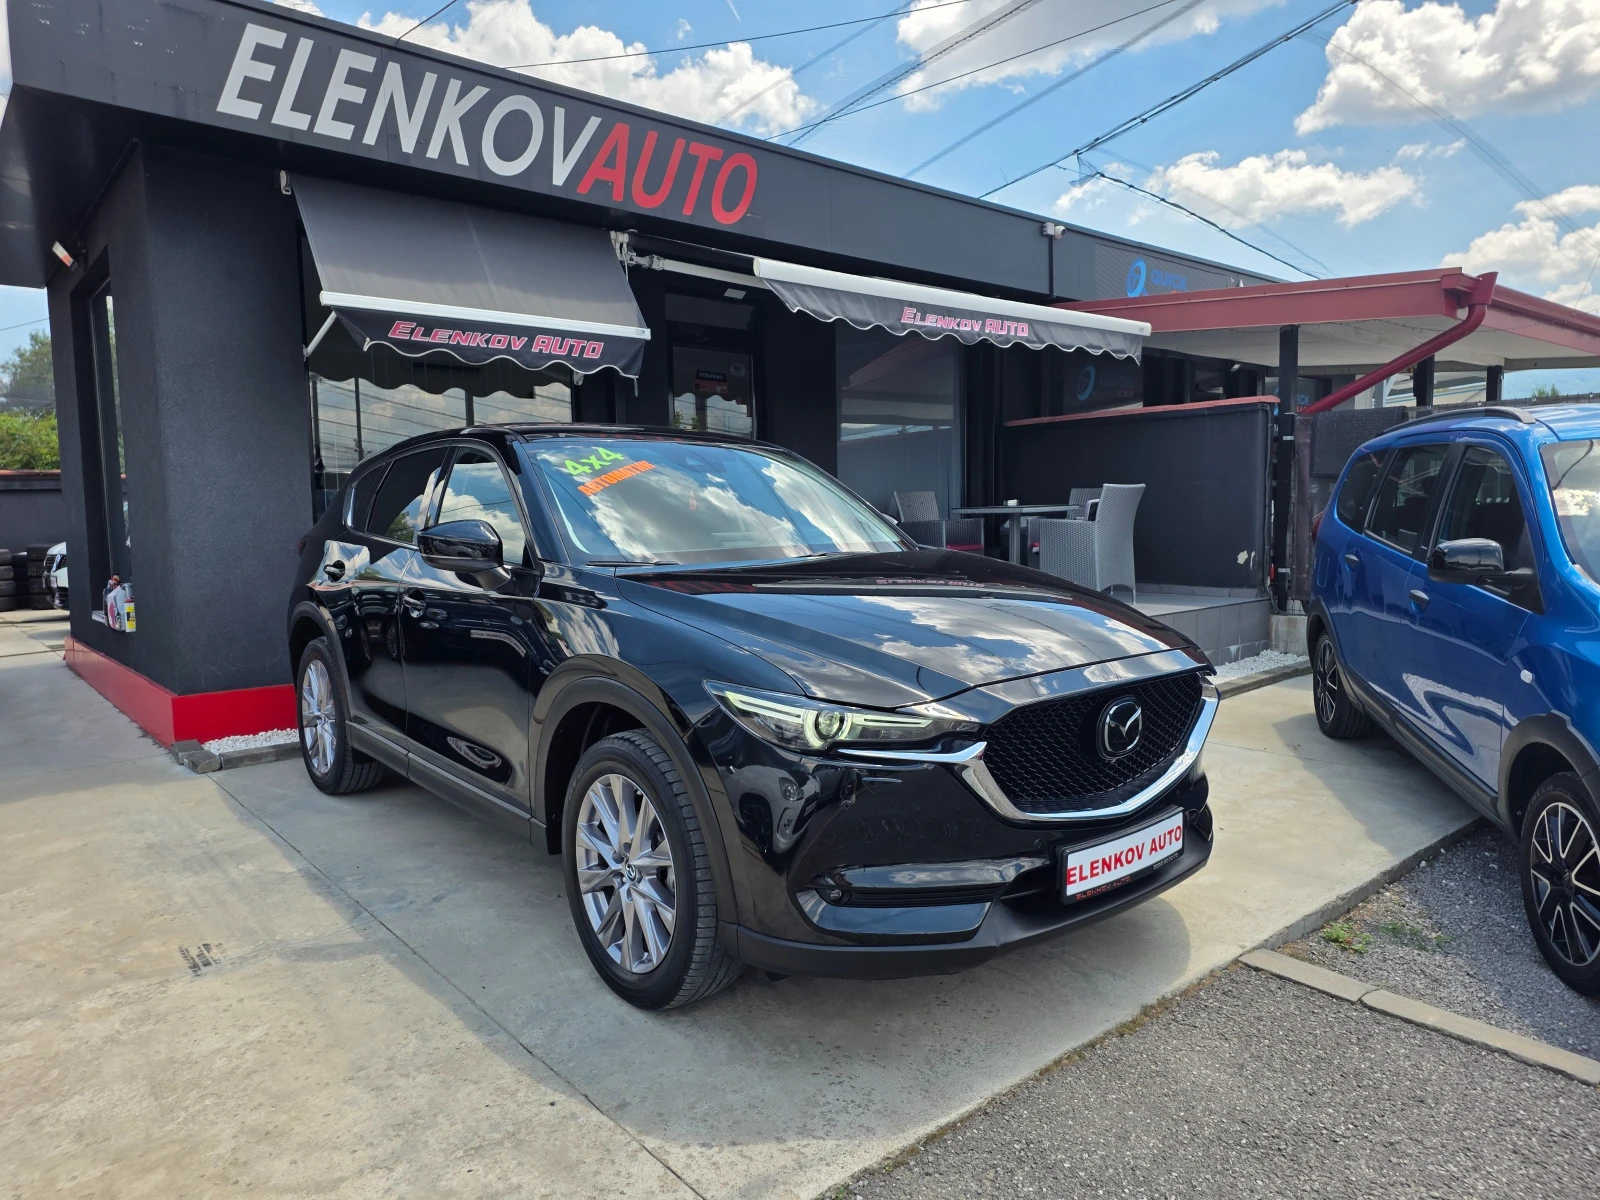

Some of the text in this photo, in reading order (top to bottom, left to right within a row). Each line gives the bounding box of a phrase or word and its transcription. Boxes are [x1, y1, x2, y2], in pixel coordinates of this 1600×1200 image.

[1150, 268, 1188, 291] QUICK
[901, 306, 1029, 337] ELENKOV AUTO
[388, 320, 604, 359] ELENKOV AUTO
[1066, 842, 1145, 886] ELENKOV
[1148, 825, 1182, 856] AUTO
